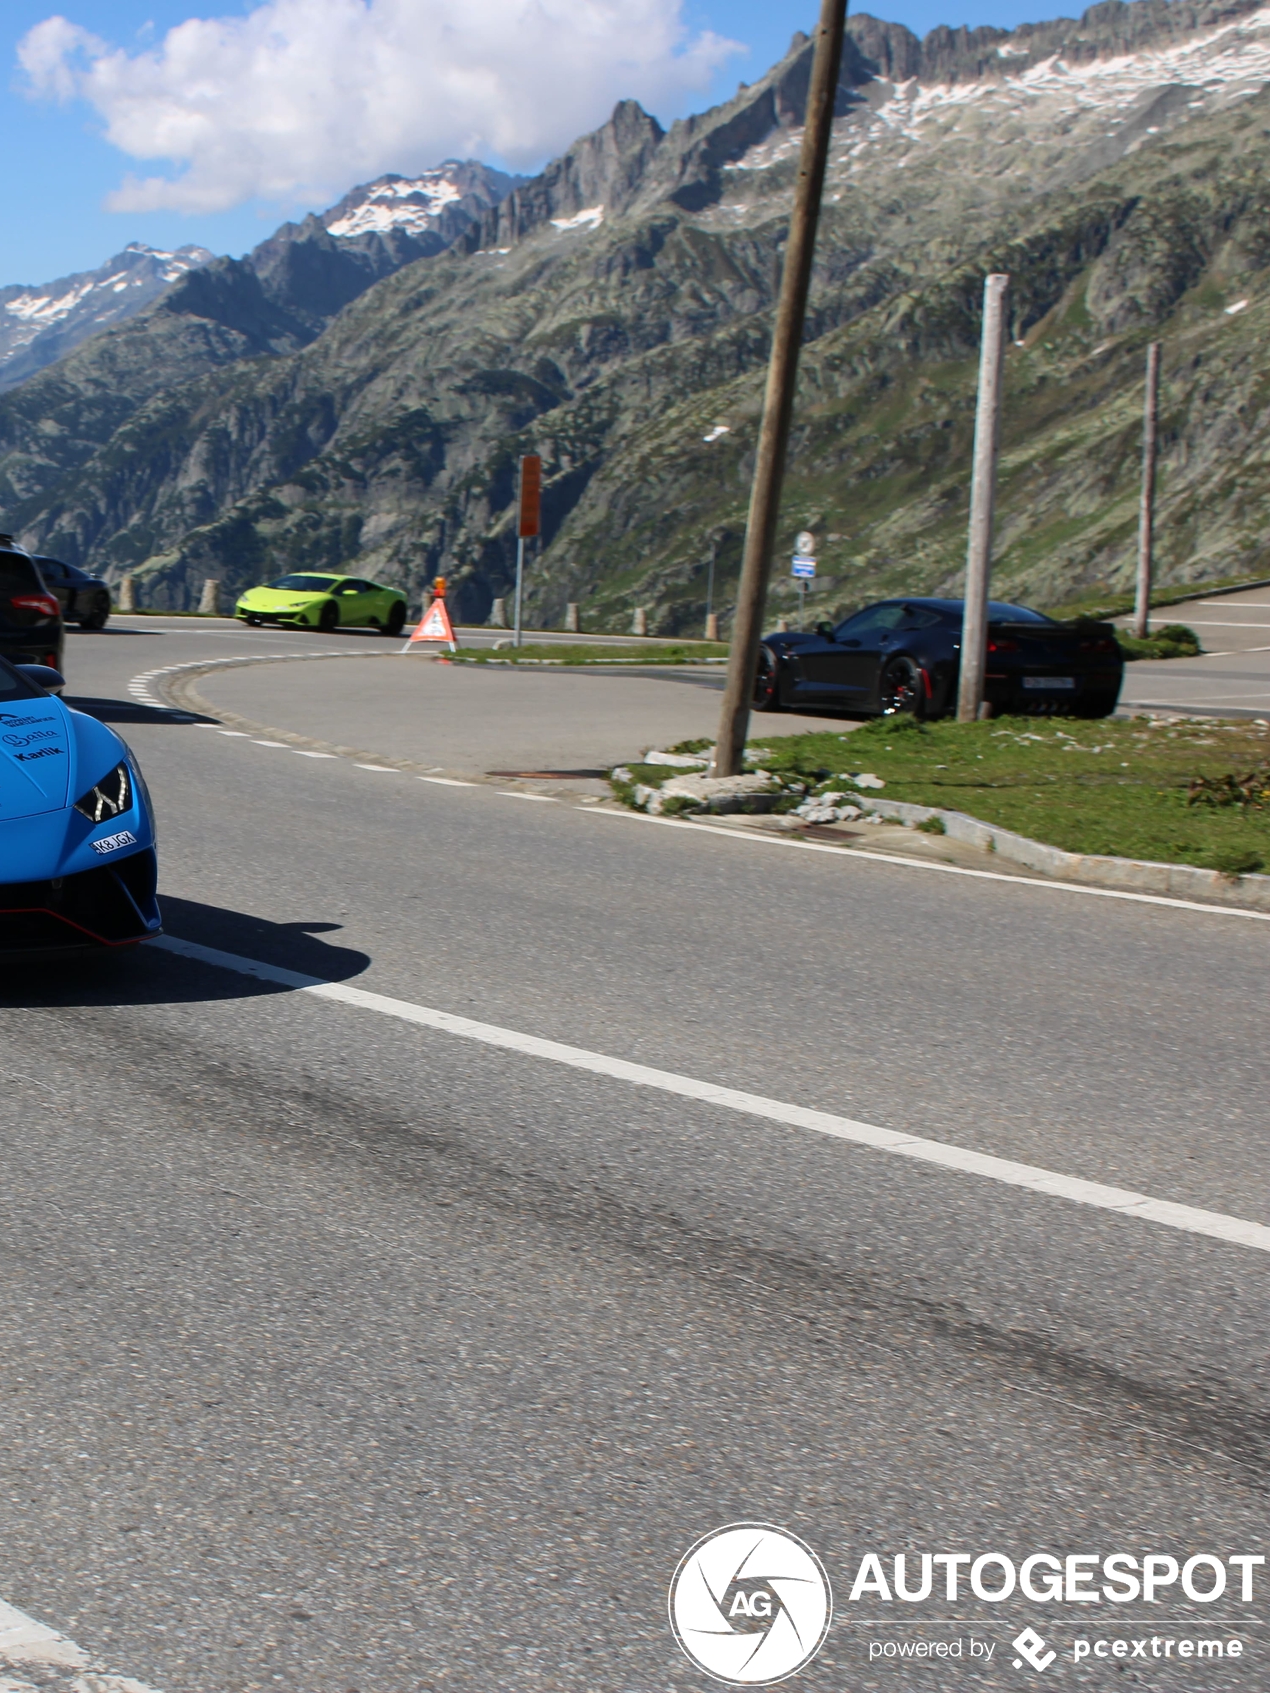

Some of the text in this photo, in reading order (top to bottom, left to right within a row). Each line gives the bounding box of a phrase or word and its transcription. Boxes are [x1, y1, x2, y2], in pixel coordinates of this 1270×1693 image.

[13, 747, 64, 761] Karlik
[96, 832, 135, 852] K8 JGX
